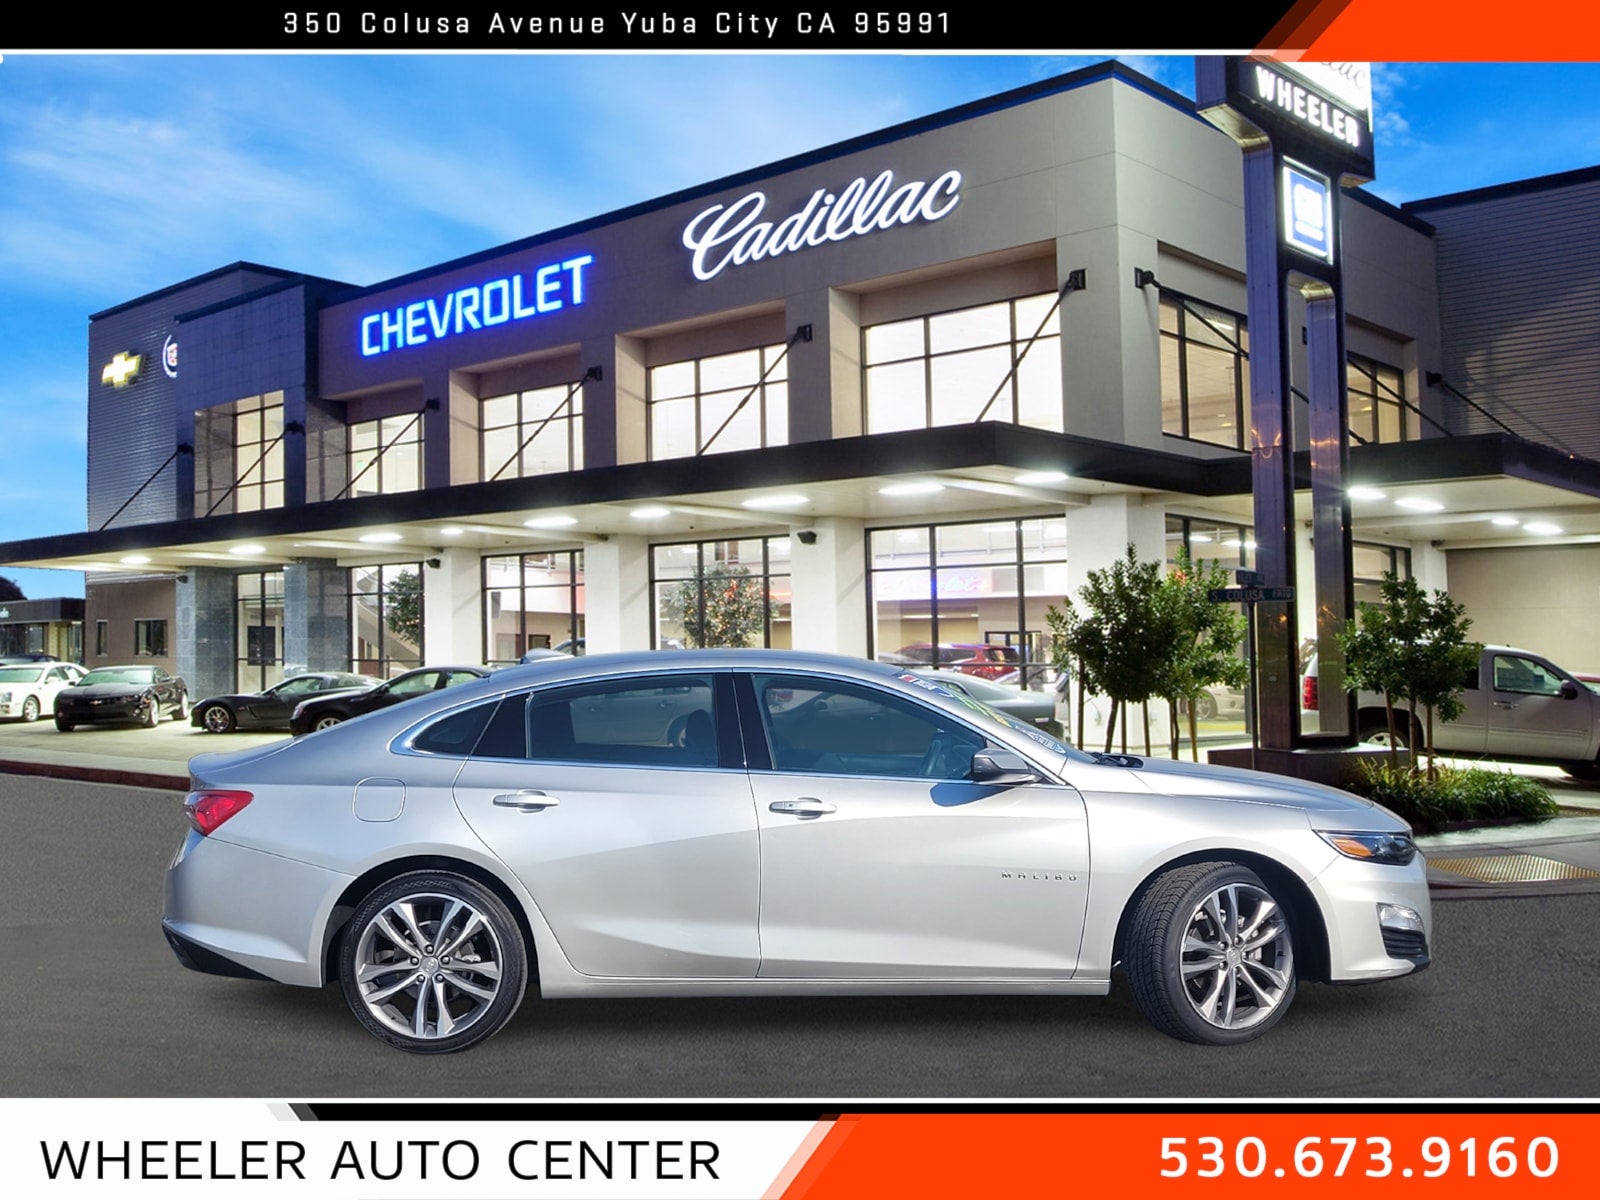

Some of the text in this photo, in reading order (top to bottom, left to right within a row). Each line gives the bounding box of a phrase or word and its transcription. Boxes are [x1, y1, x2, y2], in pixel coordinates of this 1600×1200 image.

[1255, 65, 1359, 148] WHEELER
[682, 169, 962, 281] Cadillac
[361, 254, 593, 357] CHEVROLET
[1226, 589, 1265, 601] COLUSA
[1001, 871, 1078, 881] MALIBU
